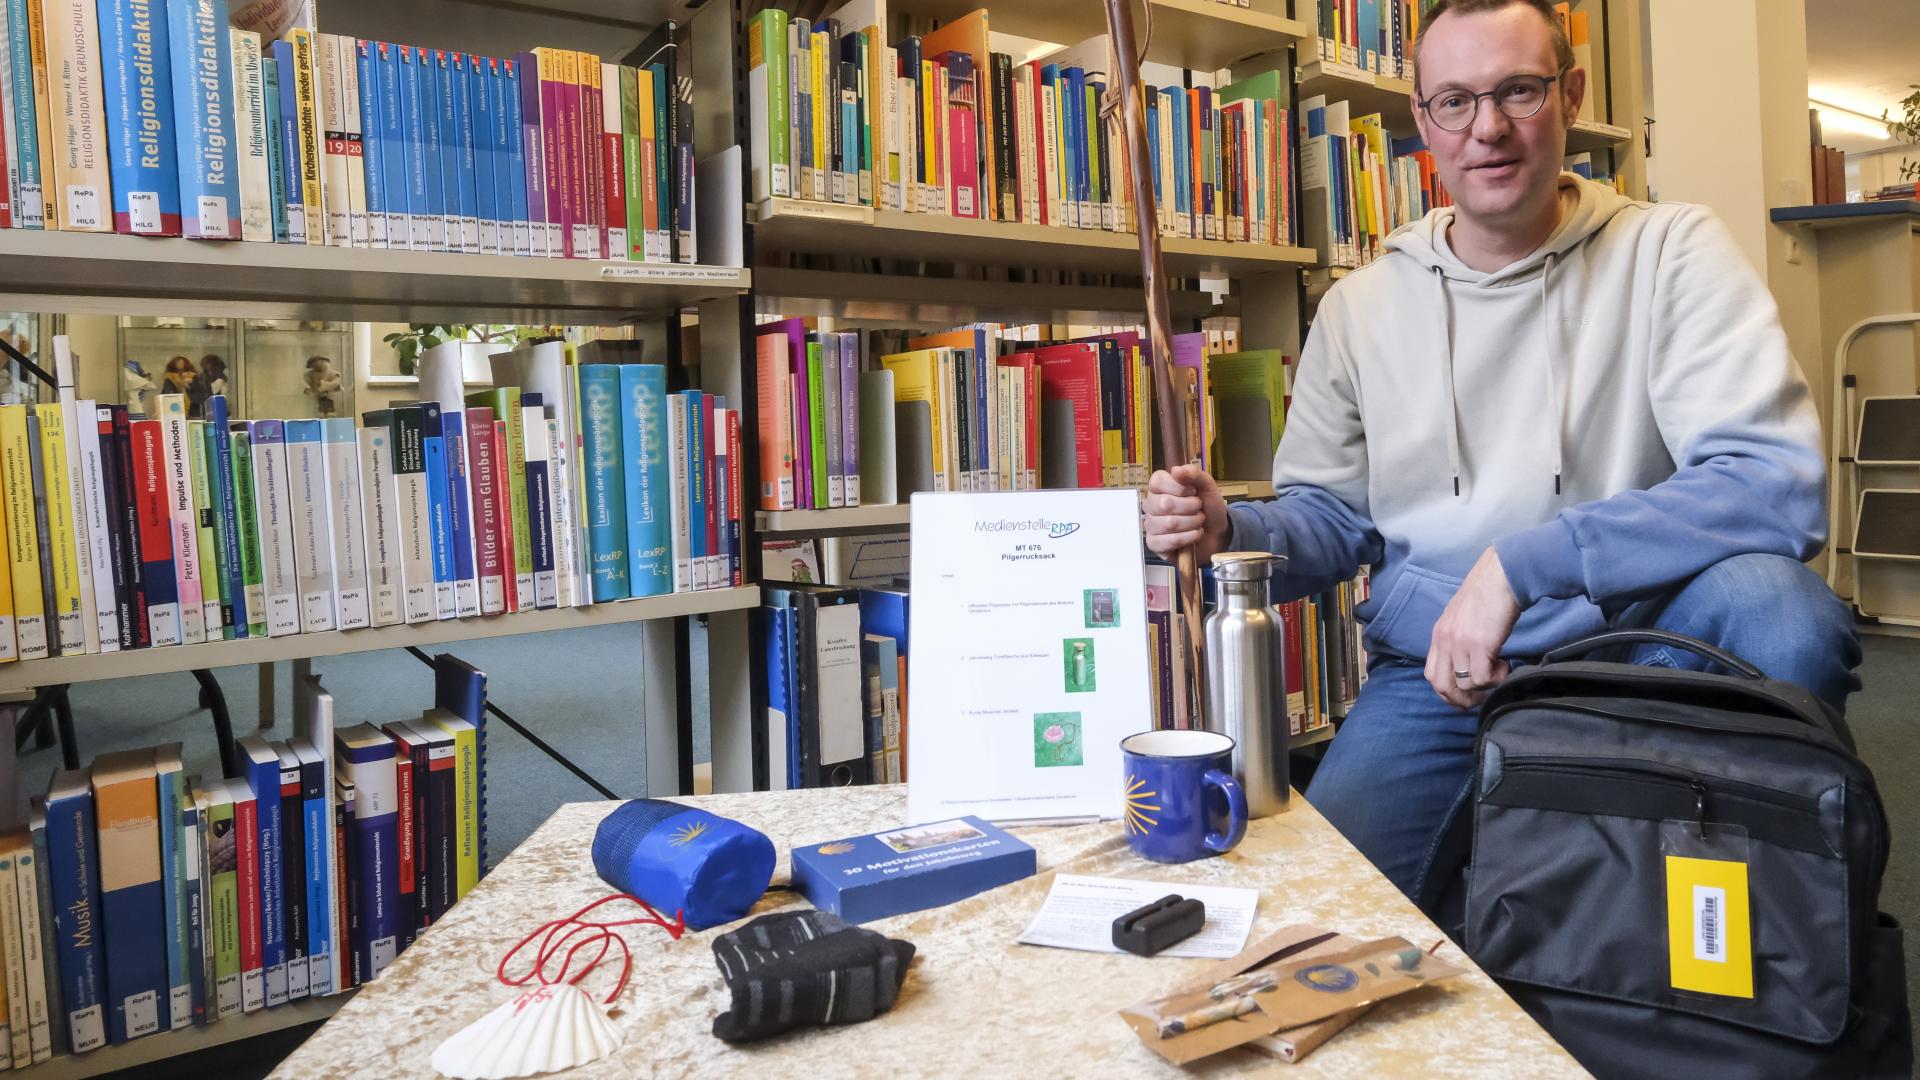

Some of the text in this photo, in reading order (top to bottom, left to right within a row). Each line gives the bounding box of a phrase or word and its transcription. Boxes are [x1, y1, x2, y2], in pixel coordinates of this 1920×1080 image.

[63, 60, 71, 80] Ritter
[73, 2, 94, 169] RELIGIONSDIDAKTIK GRUNDSCHULE
[129, 0, 160, 168] Religionsdidakti
[888, 55, 896, 112] Bibel erzählen
[65, 89, 74, 116] Werner
[327, 59, 338, 126] Die Gewalt und das
[67, 124, 77, 145] Hilger
[247, 74, 265, 157] Religionsunterricht im
[300, 72, 316, 180] Kirchengeschichte wieder
[69, 147, 79, 169] Georg
[328, 141, 345, 153] 19
[349, 145, 362, 154] 20
[510, 400, 524, 476] Leben lernen
[636, 398, 648, 473] Religionspädagogik
[692, 404, 700, 462] Religionsunterricht
[7, 448, 17, 495] Religionsunterricht
[143, 430, 156, 492] Religionspädagogik
[170, 420, 187, 510] Impulse und Methoden
[222, 453, 232, 499] Religionsunterricht
[591, 399, 607, 523] Lexikon der Religionspädagogik
[410, 479, 419, 529] Religionspädagogik
[479, 442, 497, 567] Bilder zum Glauben
[552, 461, 563, 523] Interreligiöses
[642, 491, 650, 519] Lexikon
[11, 503, 23, 562] Kompetenzorientierung
[974, 518, 1074, 534] Medienstelle RPA
[180, 523, 193, 580] Peter Kliemann
[230, 546, 238, 561] besten
[594, 551, 623, 562] LexRP
[638, 547, 666, 558] LexRP
[1001, 553, 1056, 561] Pilgerrucksack
[18, 617, 40, 625] RePä
[121, 602, 131, 647] Kohlhammer
[154, 610, 170, 618] RePä
[276, 621, 294, 629] LACH
[21, 645, 46, 654] KOMP
[61, 641, 84, 649] KONF
[462, 745, 472, 820] Religionspädagogik
[403, 822, 412, 860] Grundlegung
[843, 839, 1001, 876] 30 Motivationskarten
[68, 811, 92, 947] Musik Schule und Gemeinde
[883, 851, 983, 875] für den Jakobsweg
[219, 1002, 240, 1013] OBST
[79, 1038, 98, 1048] MUSI
